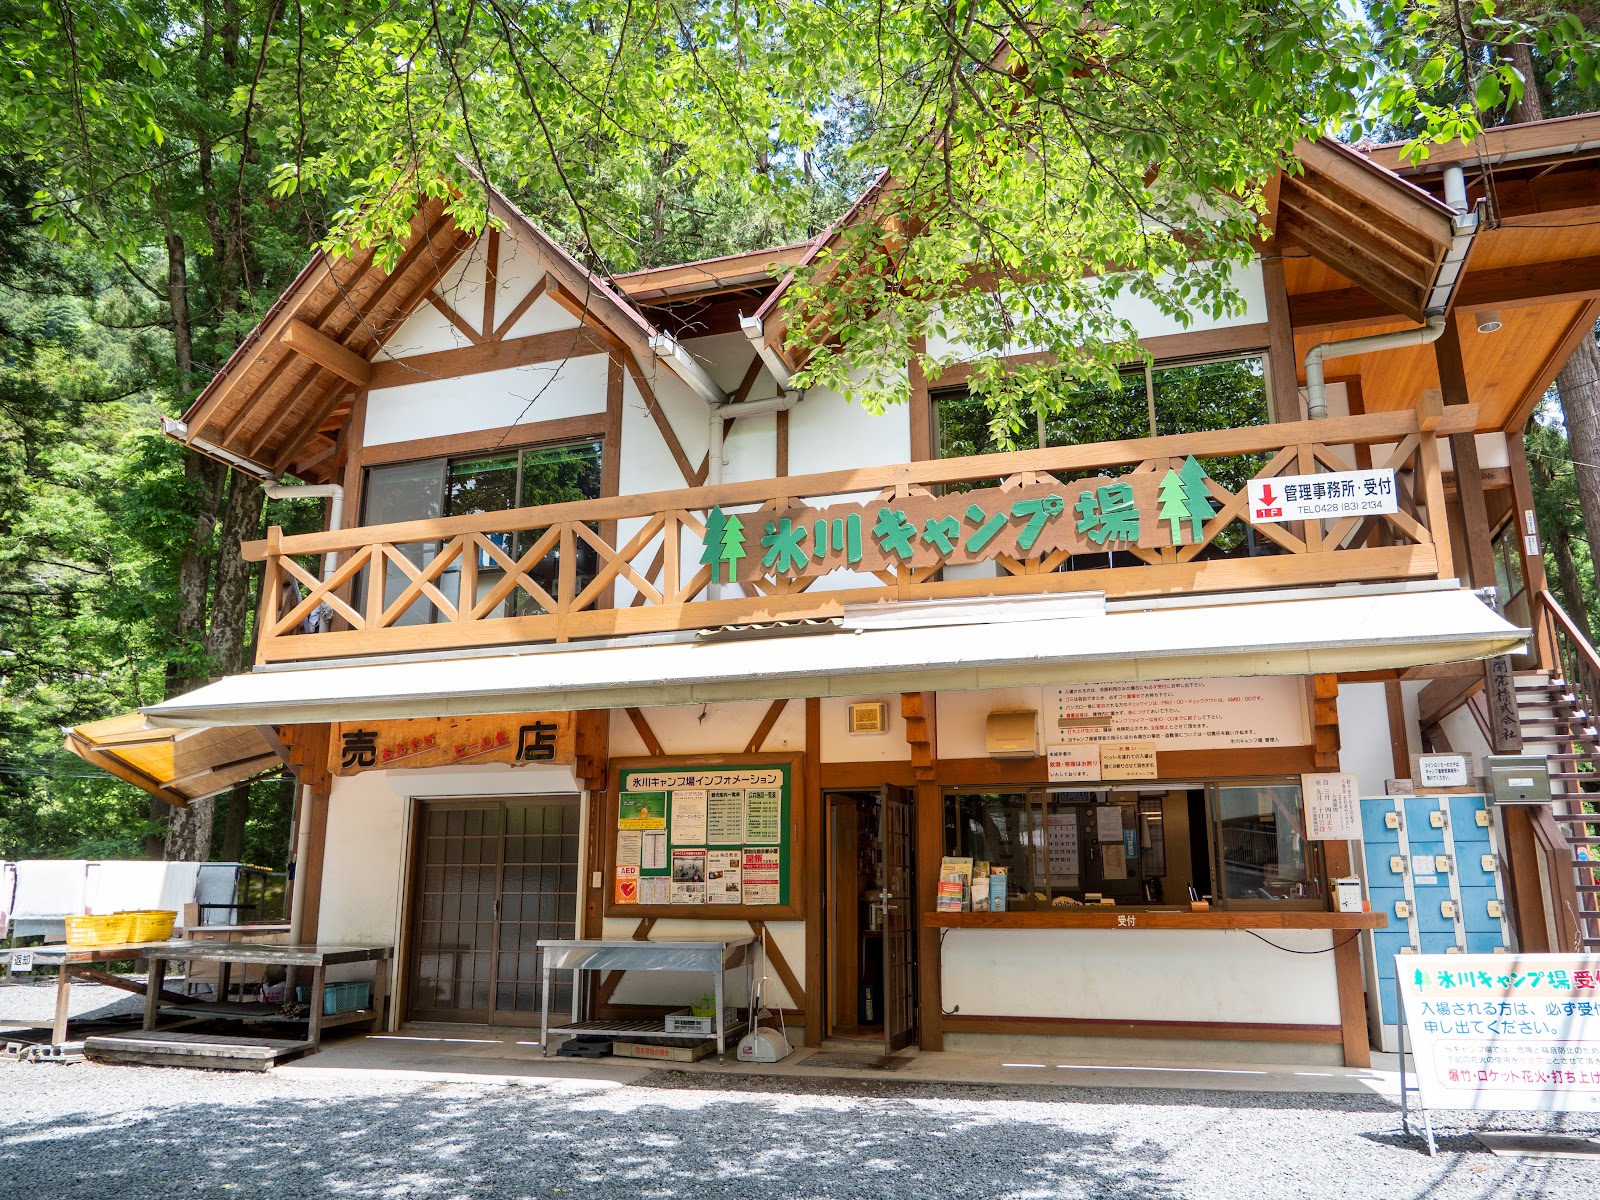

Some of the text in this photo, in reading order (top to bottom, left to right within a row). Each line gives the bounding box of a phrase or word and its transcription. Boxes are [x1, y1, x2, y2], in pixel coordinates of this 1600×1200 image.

[1284, 477, 1391, 502] 管理事務所・受付
[1361, 501, 1383, 510] 2134
[761, 481, 1141, 574] 氷川キャンプ場
[632, 774, 777, 788] 氷川キャンプ場インフォメーション
[1117, 915, 1137, 927] 受付
[14, 954, 31, 966] 返却
[1437, 969, 1571, 991] 氷川キャンプ場
[1424, 1019, 1558, 1035] 申し出てください。
